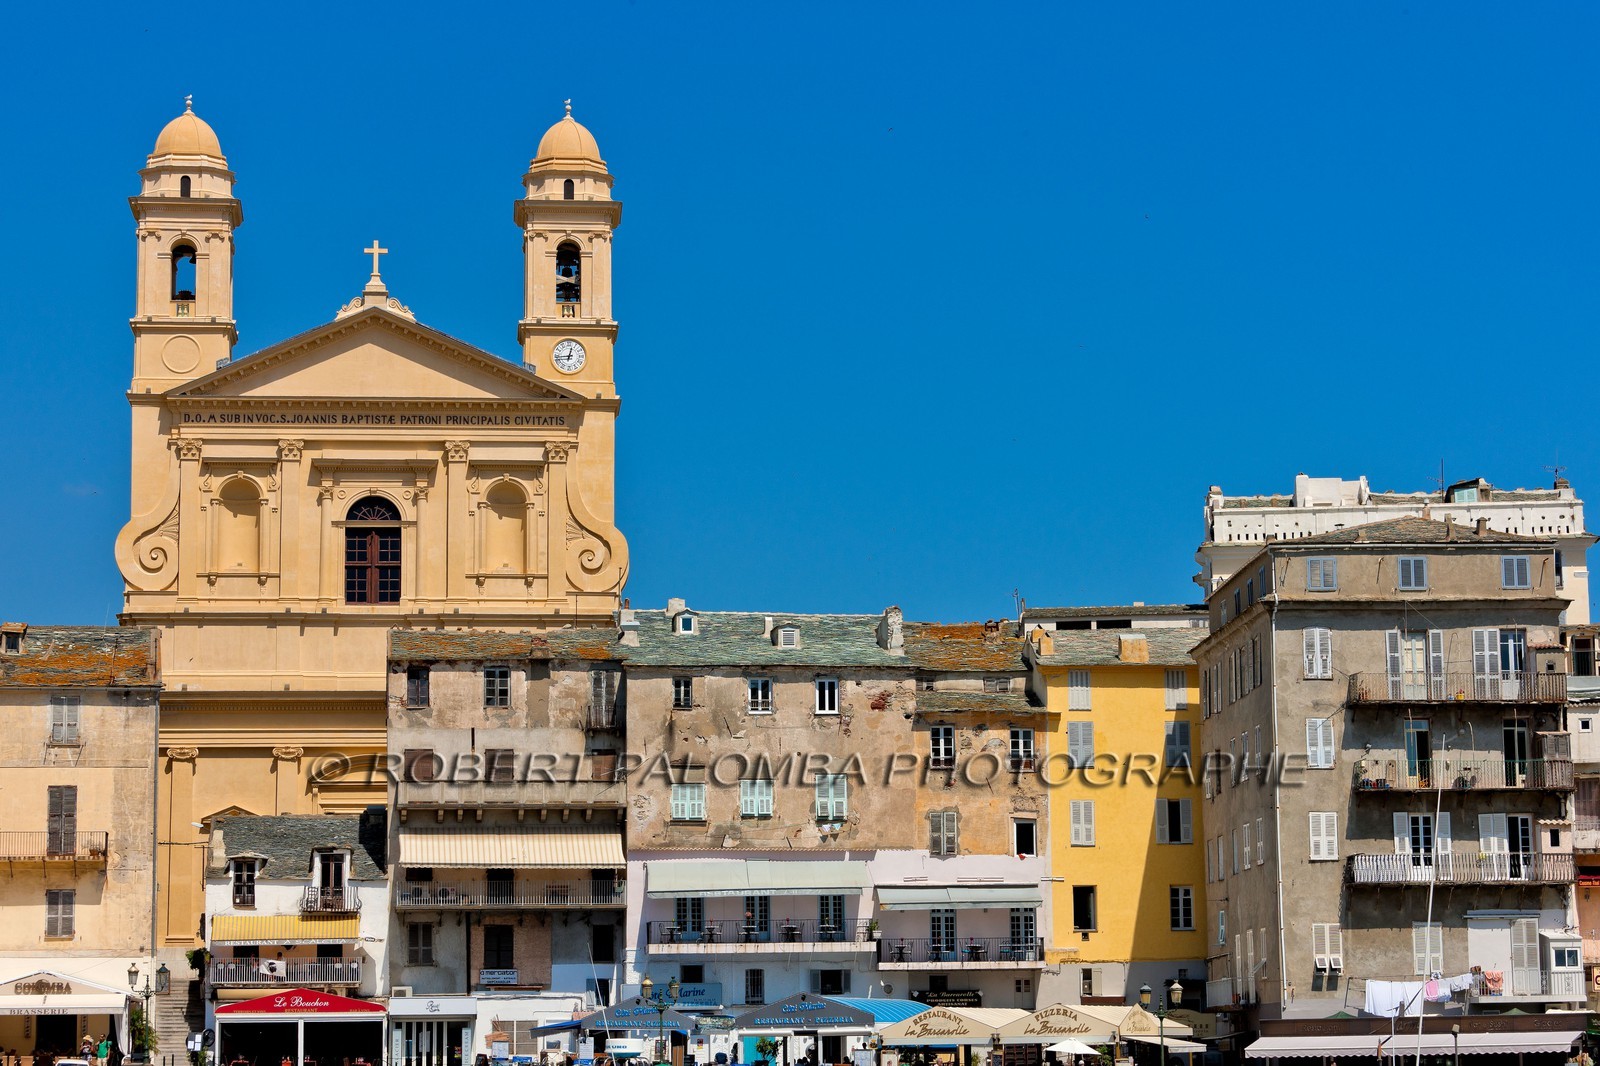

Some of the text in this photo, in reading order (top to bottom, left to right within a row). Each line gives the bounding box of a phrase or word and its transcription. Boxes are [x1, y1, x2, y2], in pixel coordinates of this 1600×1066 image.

[219, 413, 241, 424] SUB
[400, 415, 442, 425] PATRONI
[445, 415, 511, 425] PRINCIPALIS
[514, 416, 565, 426] CIVITATIS
[273, 995, 330, 1008] Le Bouchon
[754, 1017, 806, 1025] RESTAURANT
[814, 1016, 854, 1024] PIZZERIA
[912, 1010, 964, 1026] RESTAURANT
[1034, 1008, 1078, 1022] PIZZERIA
[904, 1023, 970, 1039] La Barcarolle
[1024, 1020, 1092, 1036] La Barcarolle
